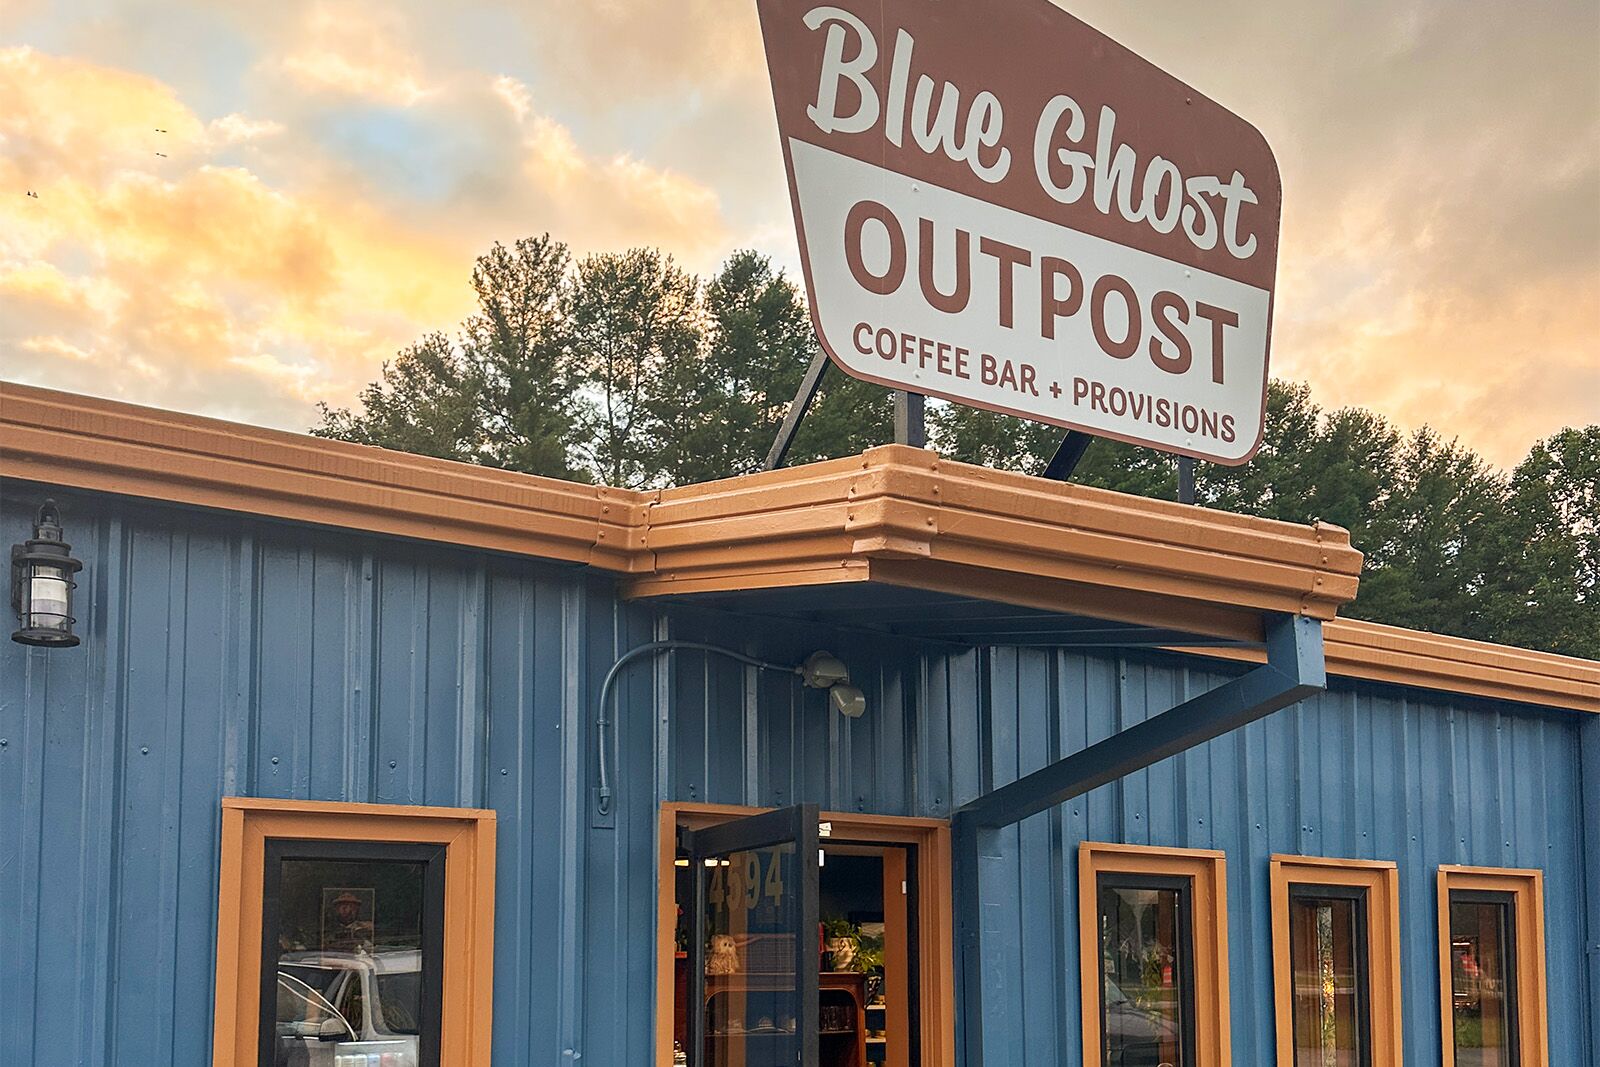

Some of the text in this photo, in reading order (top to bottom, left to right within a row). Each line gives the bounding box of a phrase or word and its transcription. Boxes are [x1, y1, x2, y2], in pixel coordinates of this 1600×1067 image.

[803, 6, 1259, 260] Blue Ghost
[844, 200, 1239, 385] OUTPOST
[852, 321, 1236, 443] COFFEE BAR + PROVISIONS
[709, 846, 784, 912] 4594
